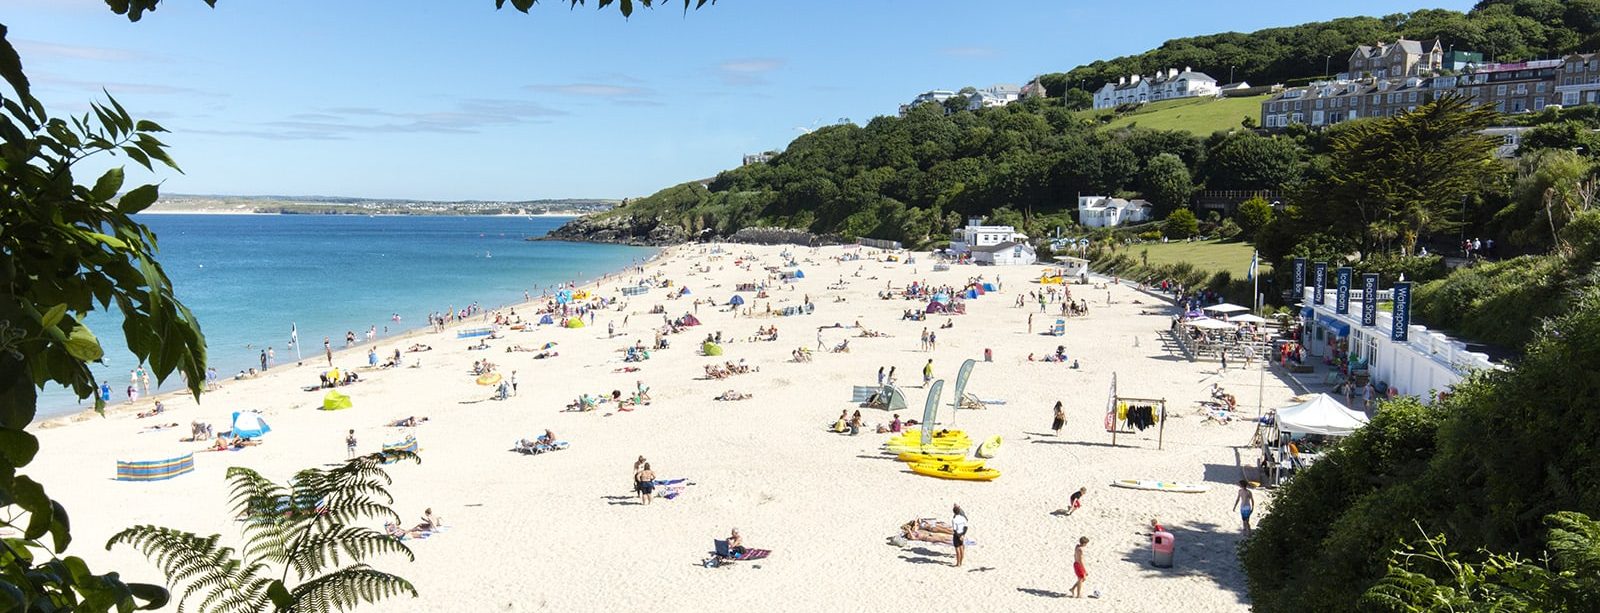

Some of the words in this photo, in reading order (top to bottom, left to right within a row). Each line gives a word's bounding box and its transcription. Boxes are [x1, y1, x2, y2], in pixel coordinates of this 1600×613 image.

[1315, 267, 1324, 302] Take-Away
[1366, 278, 1374, 303] Beach
[1339, 285, 1347, 310] Cream
[1364, 304, 1374, 324] Shop
[1395, 287, 1407, 338] Watersports
